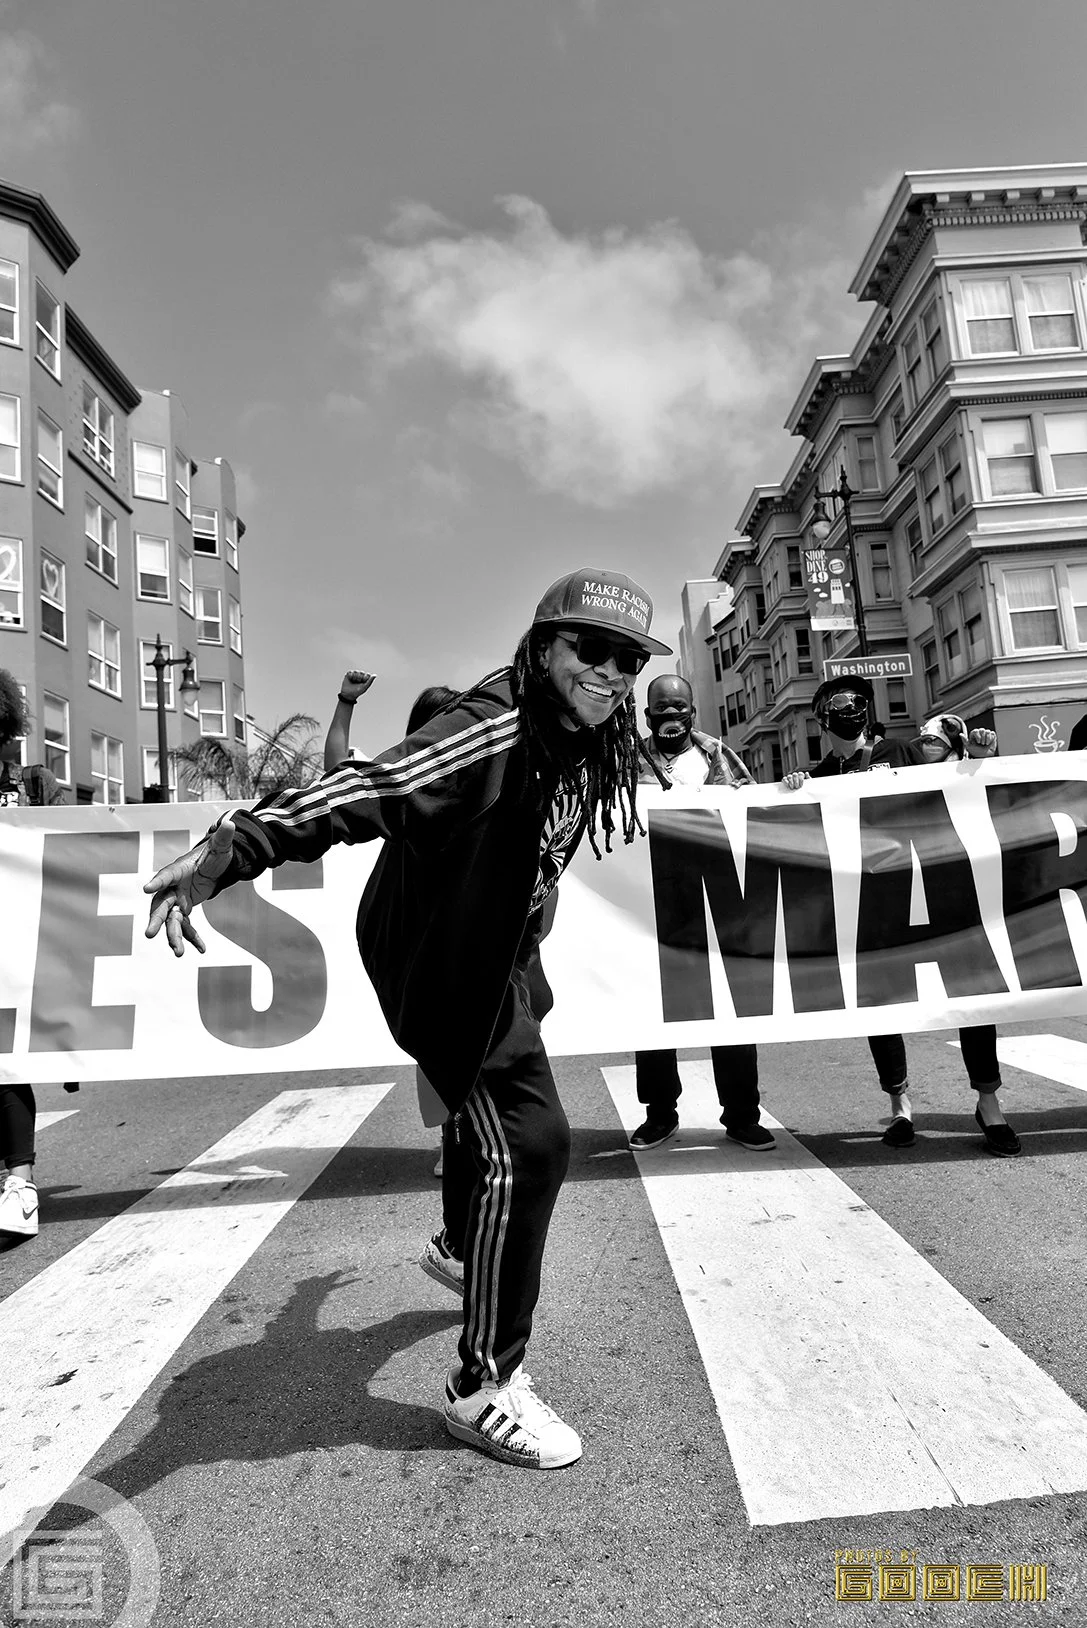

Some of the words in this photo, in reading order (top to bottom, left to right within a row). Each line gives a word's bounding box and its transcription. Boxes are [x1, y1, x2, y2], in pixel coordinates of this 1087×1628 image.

[807, 571, 829, 584] 49
[583, 581, 620, 598] MAKE
[581, 594, 627, 613] WRONG
[831, 661, 906, 677] Washington
[647, 780, 1087, 1023] MAR
